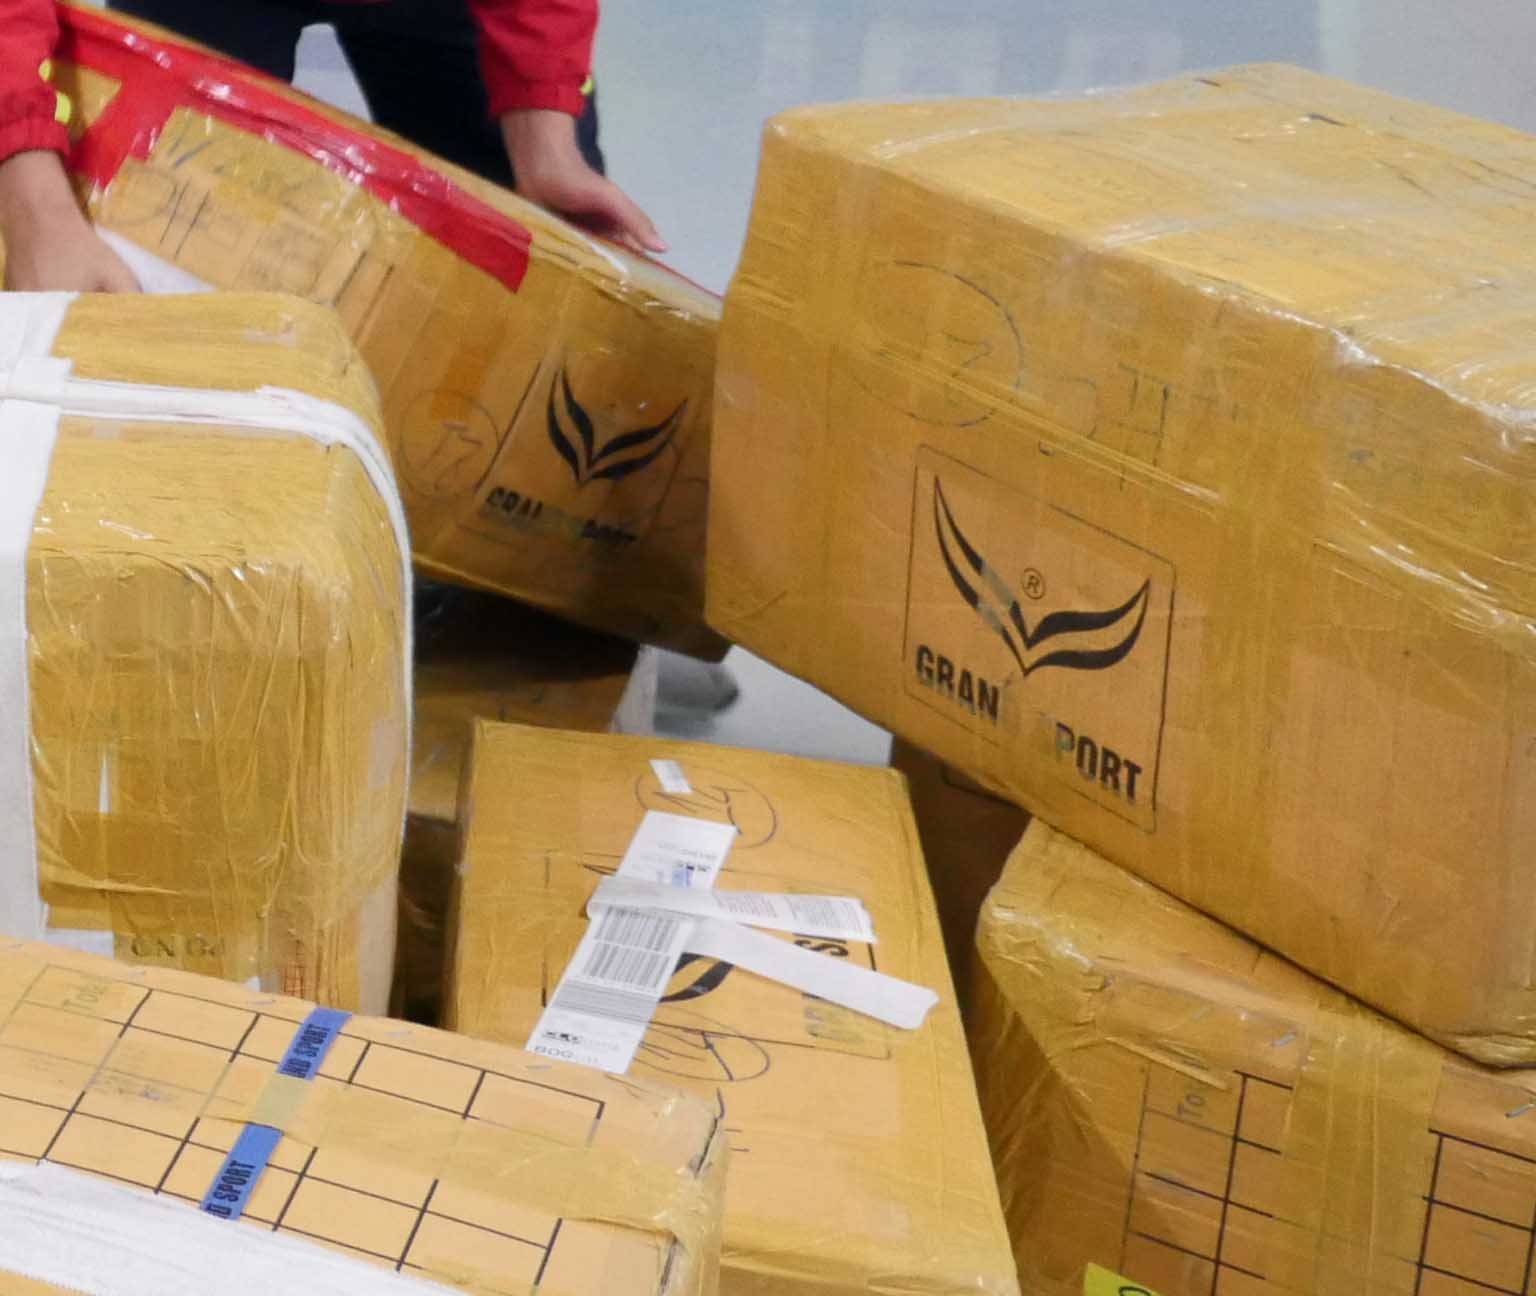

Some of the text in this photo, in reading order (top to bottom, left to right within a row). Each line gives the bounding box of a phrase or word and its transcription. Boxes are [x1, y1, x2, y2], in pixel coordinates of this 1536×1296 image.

[914, 643, 1143, 803] GRAN PORT
[293, 1023, 331, 1059] SPORT
[212, 1159, 257, 1203] SPORT
